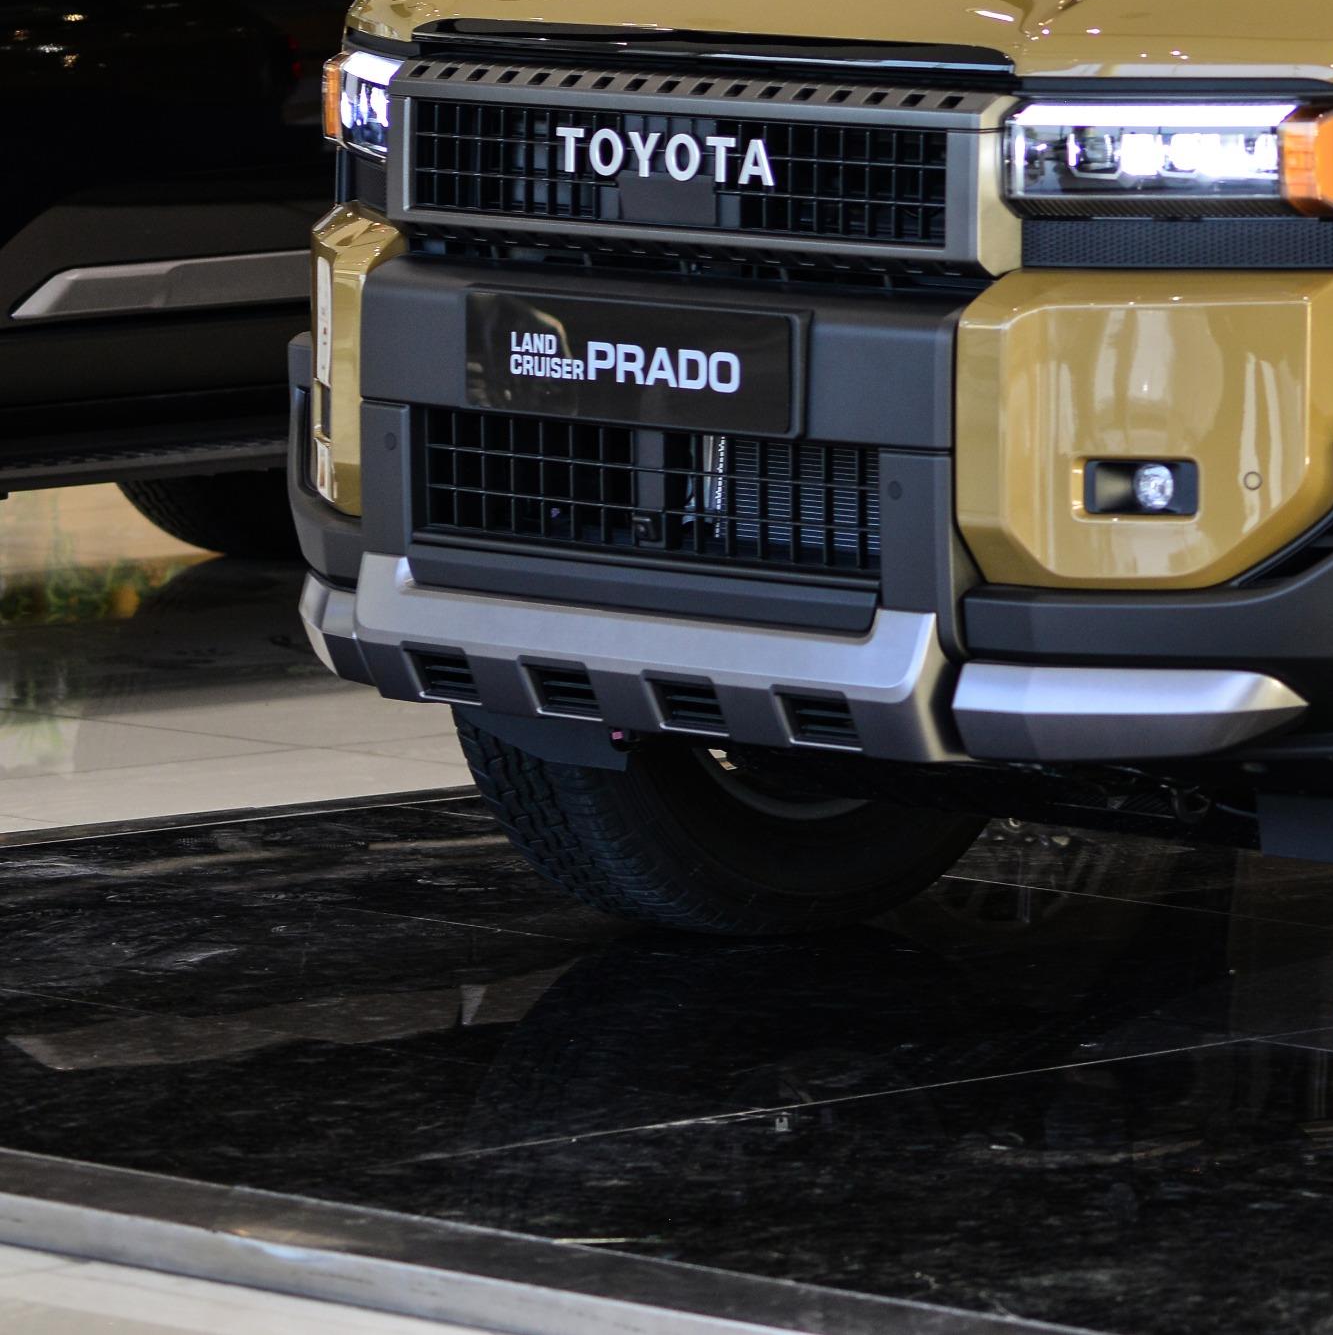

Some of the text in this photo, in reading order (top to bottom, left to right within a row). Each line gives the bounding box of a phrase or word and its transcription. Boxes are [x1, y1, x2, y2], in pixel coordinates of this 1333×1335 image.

[556, 127, 775, 186] TOYOTA
[510, 340, 741, 394] CRUISER PRADO
[511, 331, 557, 355] LAND
